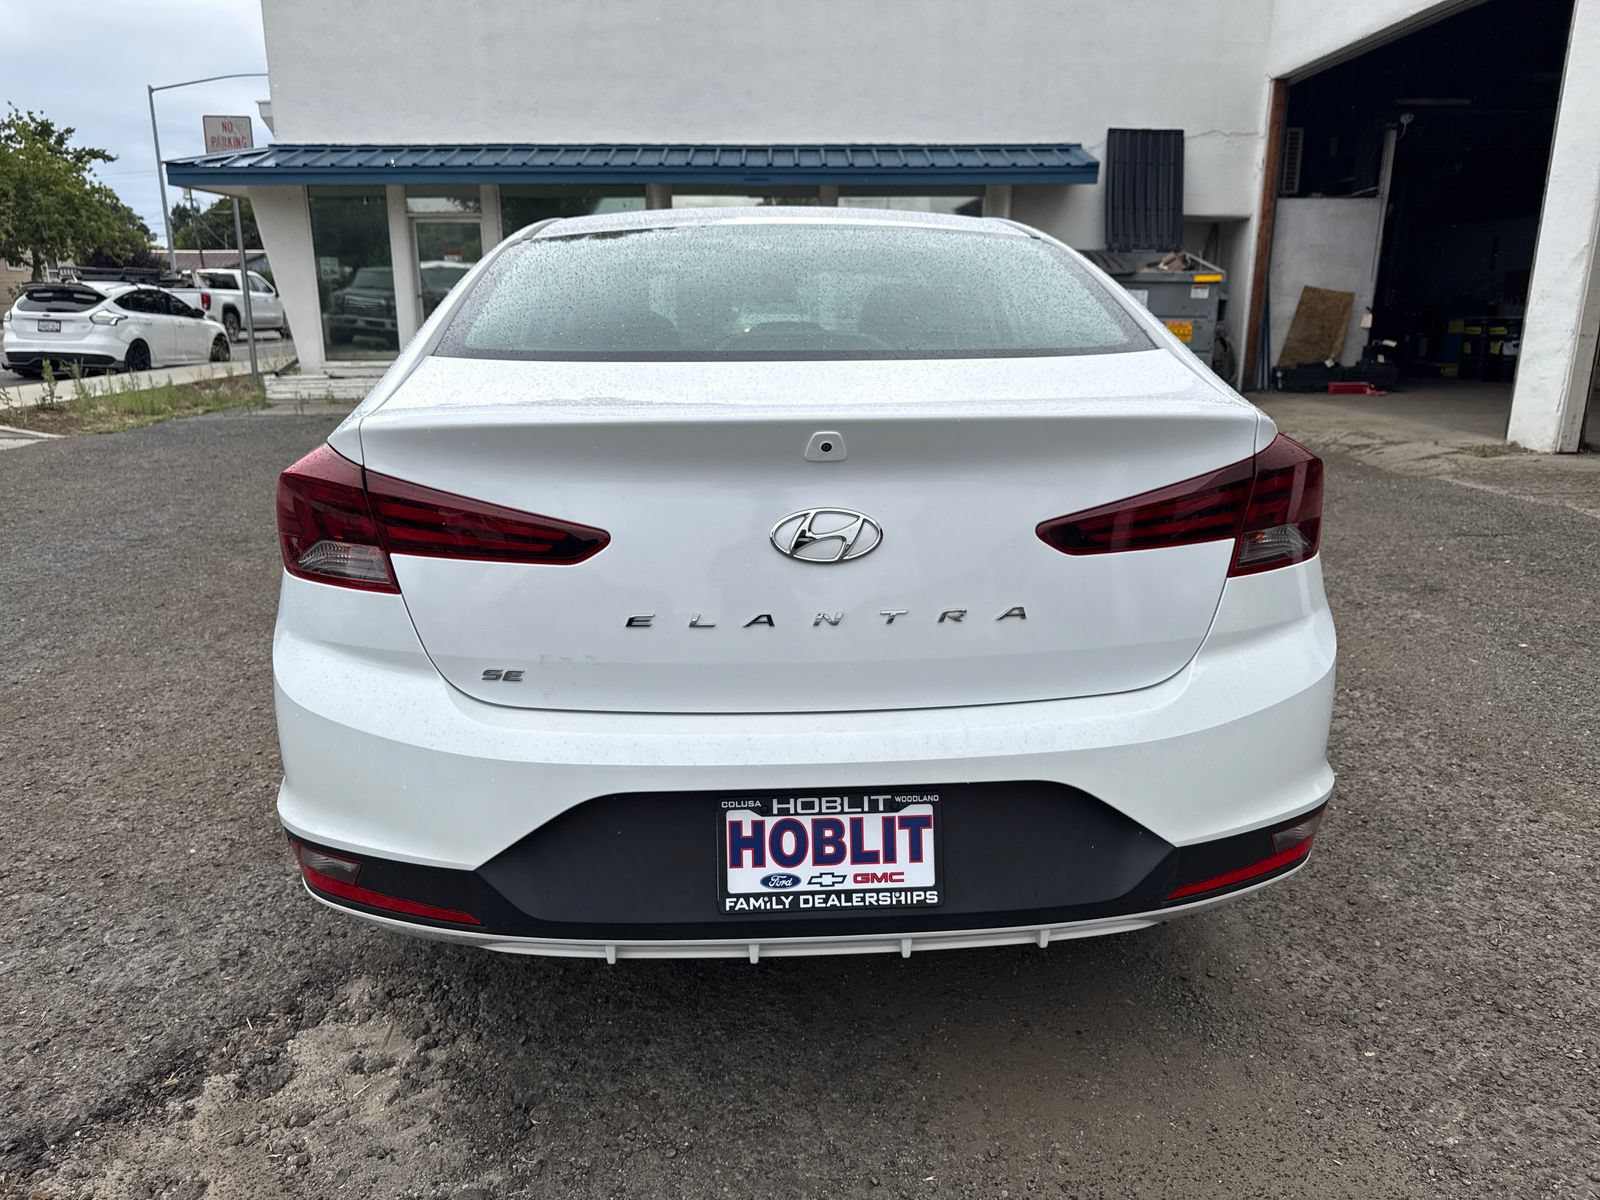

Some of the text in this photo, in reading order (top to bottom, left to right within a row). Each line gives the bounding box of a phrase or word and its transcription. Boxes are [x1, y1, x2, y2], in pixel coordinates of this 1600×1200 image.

[221, 121, 233, 133] NO
[211, 136, 247, 148] PARKING
[625, 606, 1028, 629] ELANTRA
[481, 669, 525, 682] SE
[721, 800, 762, 808] COLUSA
[773, 795, 892, 814] HOBLIT
[728, 814, 933, 869] HOBLIT
[768, 876, 793, 887] Ford
[853, 872, 905, 884] GMC
[726, 891, 938, 911] FAMILY DEALERSHIPS
